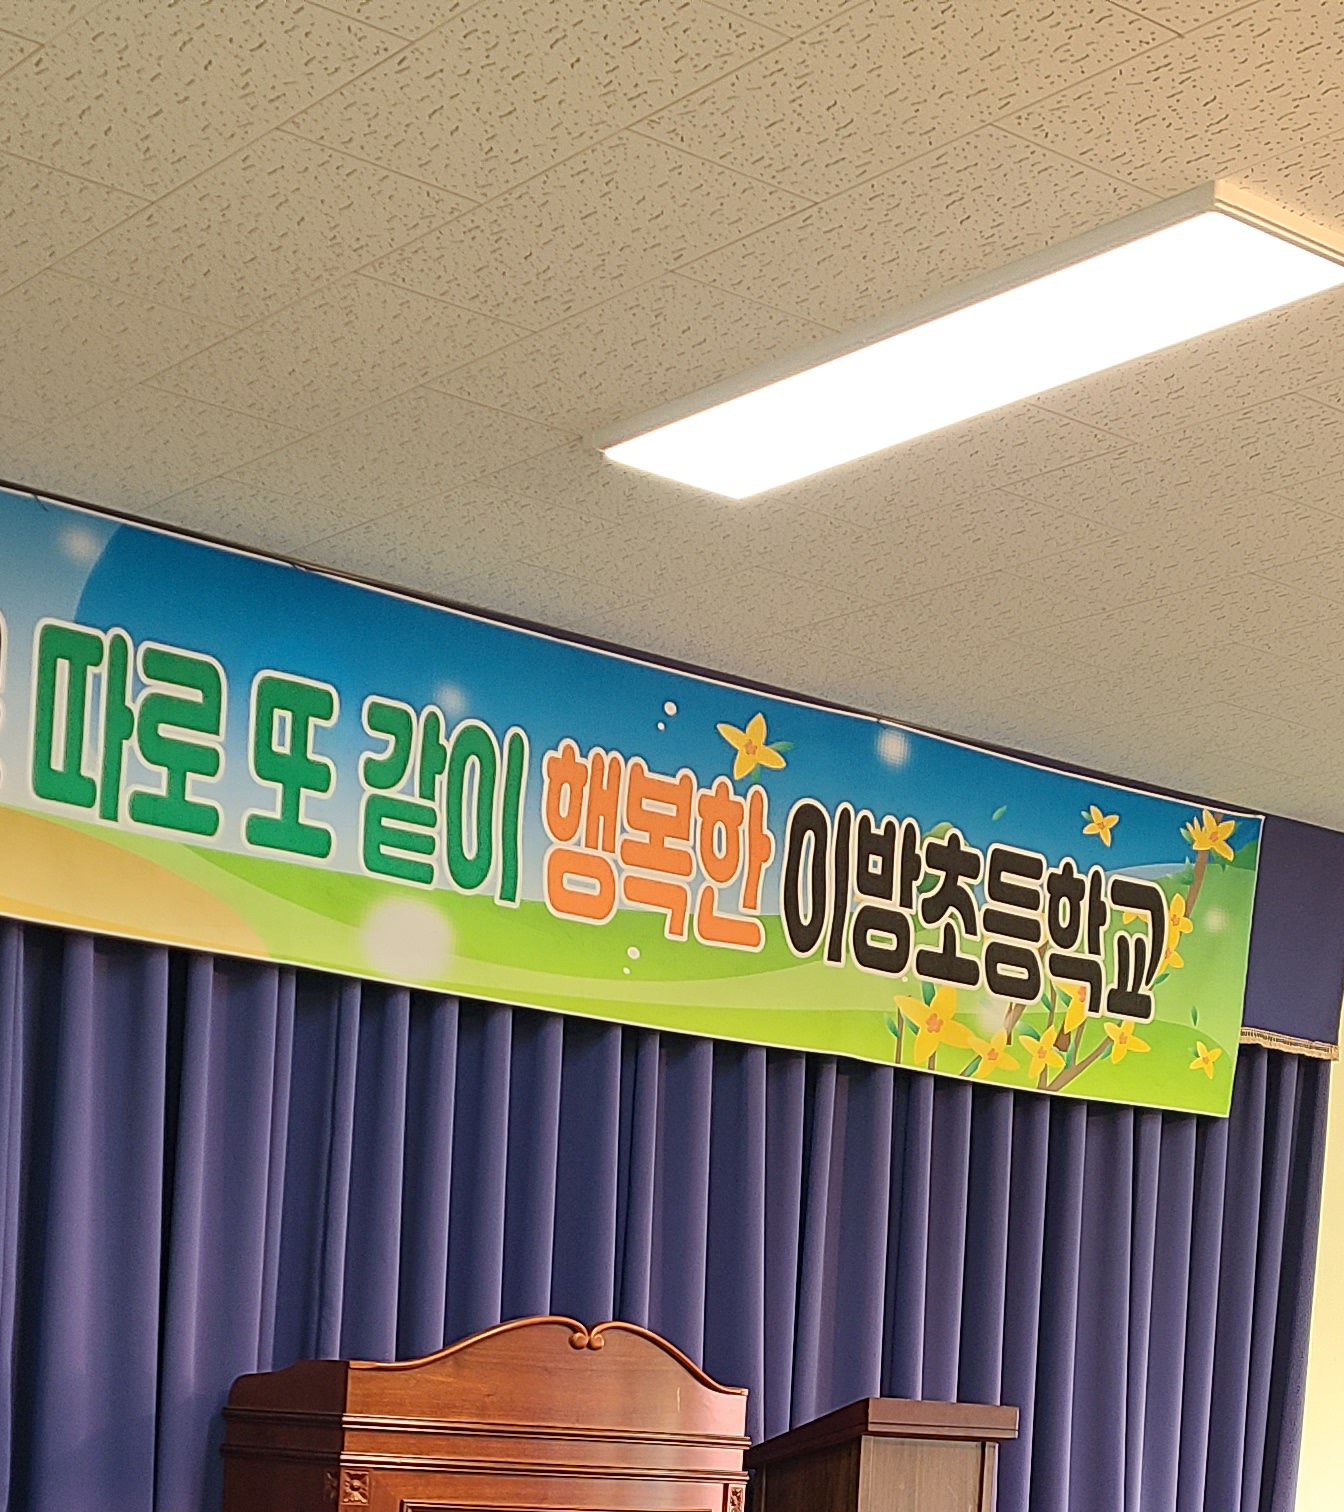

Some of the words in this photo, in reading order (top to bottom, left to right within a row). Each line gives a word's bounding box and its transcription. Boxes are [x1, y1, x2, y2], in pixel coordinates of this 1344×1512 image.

[30, 620, 224, 841] 따로
[242, 671, 338, 862] 또
[360, 697, 527, 906] 같이
[542, 741, 774, 950] 행복한
[782, 799, 1169, 1020] 이방초등학교
